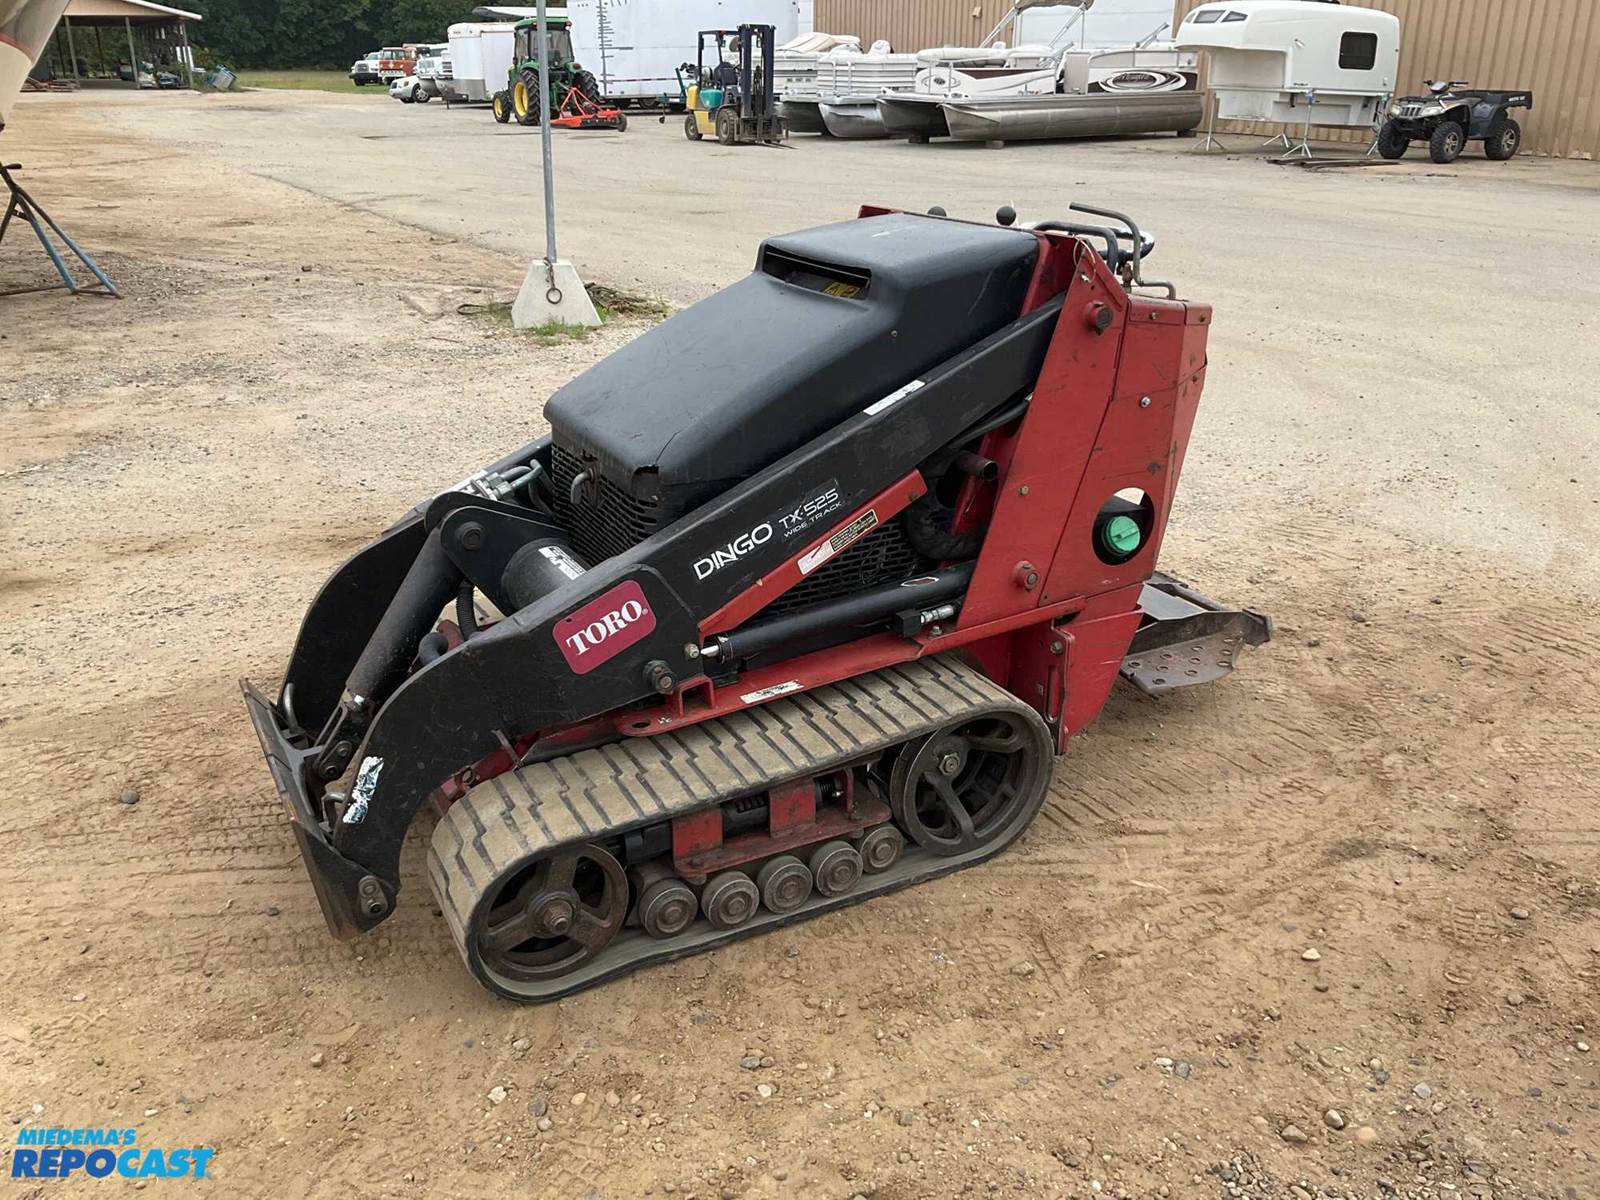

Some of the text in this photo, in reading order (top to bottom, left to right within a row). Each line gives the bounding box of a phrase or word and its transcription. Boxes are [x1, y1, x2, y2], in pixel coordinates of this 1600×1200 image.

[784, 521, 808, 538] WIDE
[810, 501, 842, 523] TRACK
[693, 520, 773, 580] DINGO
[565, 600, 642, 656] TORO
